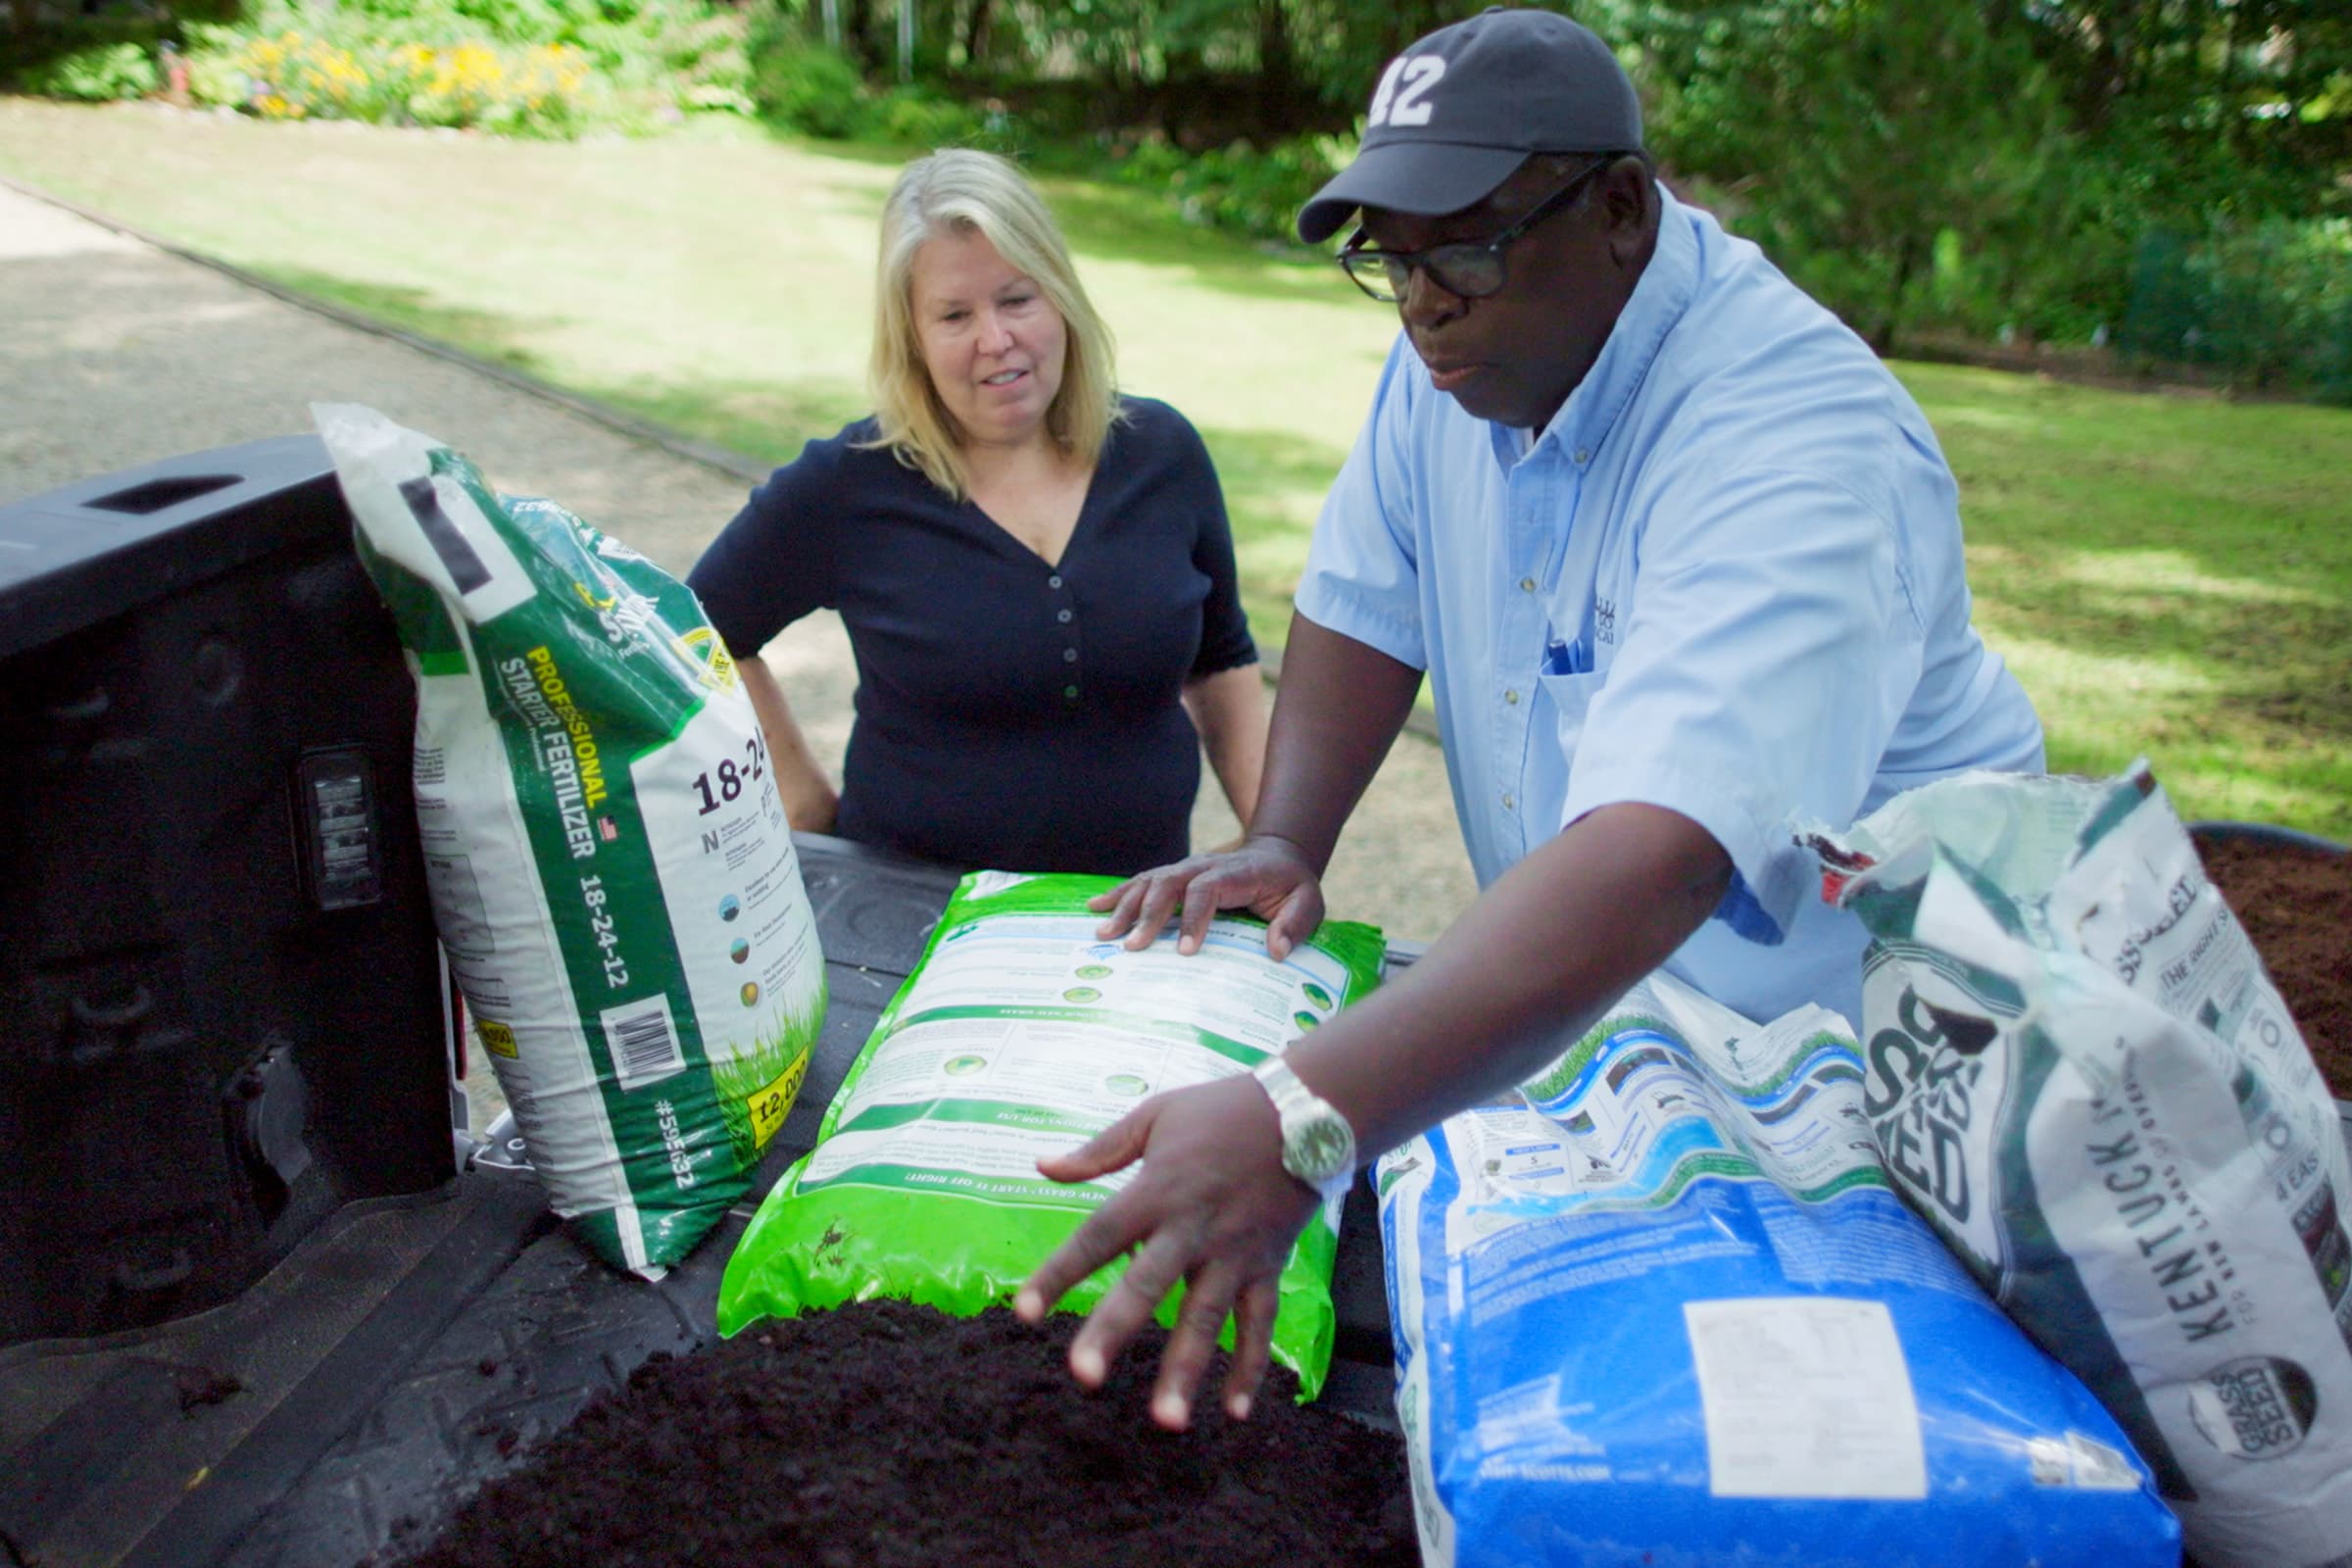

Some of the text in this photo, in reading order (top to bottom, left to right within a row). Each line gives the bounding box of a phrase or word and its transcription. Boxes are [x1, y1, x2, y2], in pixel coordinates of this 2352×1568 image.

[527, 646, 607, 808] PROFESSIONAL
[501, 657, 561, 727] STARTER
[543, 730, 596, 858] FERTILIZER
[580, 874, 629, 989] 18-24-12
[701, 829, 720, 855] N
[2211, 1372, 2266, 1452] GRASS
[2237, 1368, 2293, 1446] SEED
